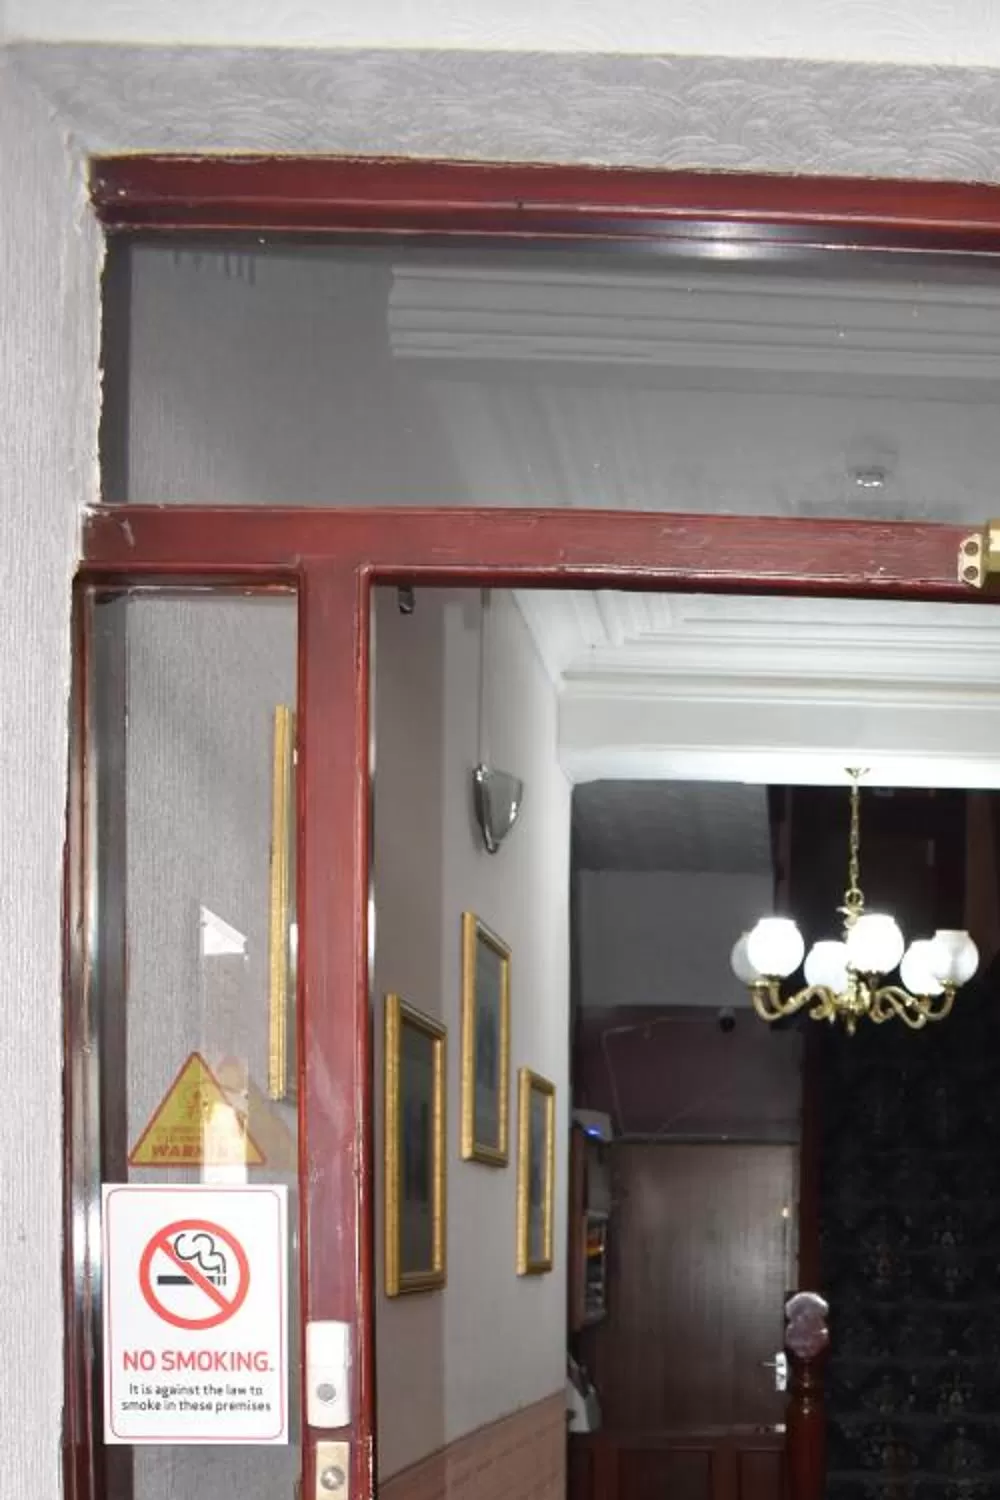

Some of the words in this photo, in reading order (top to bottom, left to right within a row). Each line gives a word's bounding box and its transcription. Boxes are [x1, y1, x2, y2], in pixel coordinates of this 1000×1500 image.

[123, 1350, 156, 1371] NO
[129, 1383, 139, 1395] It
[141, 1383, 153, 1395] is
[155, 1383, 200, 1398] against
[203, 1383, 223, 1395] the
[225, 1383, 247, 1395] law
[249, 1385, 263, 1395] to
[121, 1399, 161, 1411] smoke
[163, 1399, 177, 1411] in
[179, 1399, 213, 1411] these
[215, 1399, 271, 1414] premises
